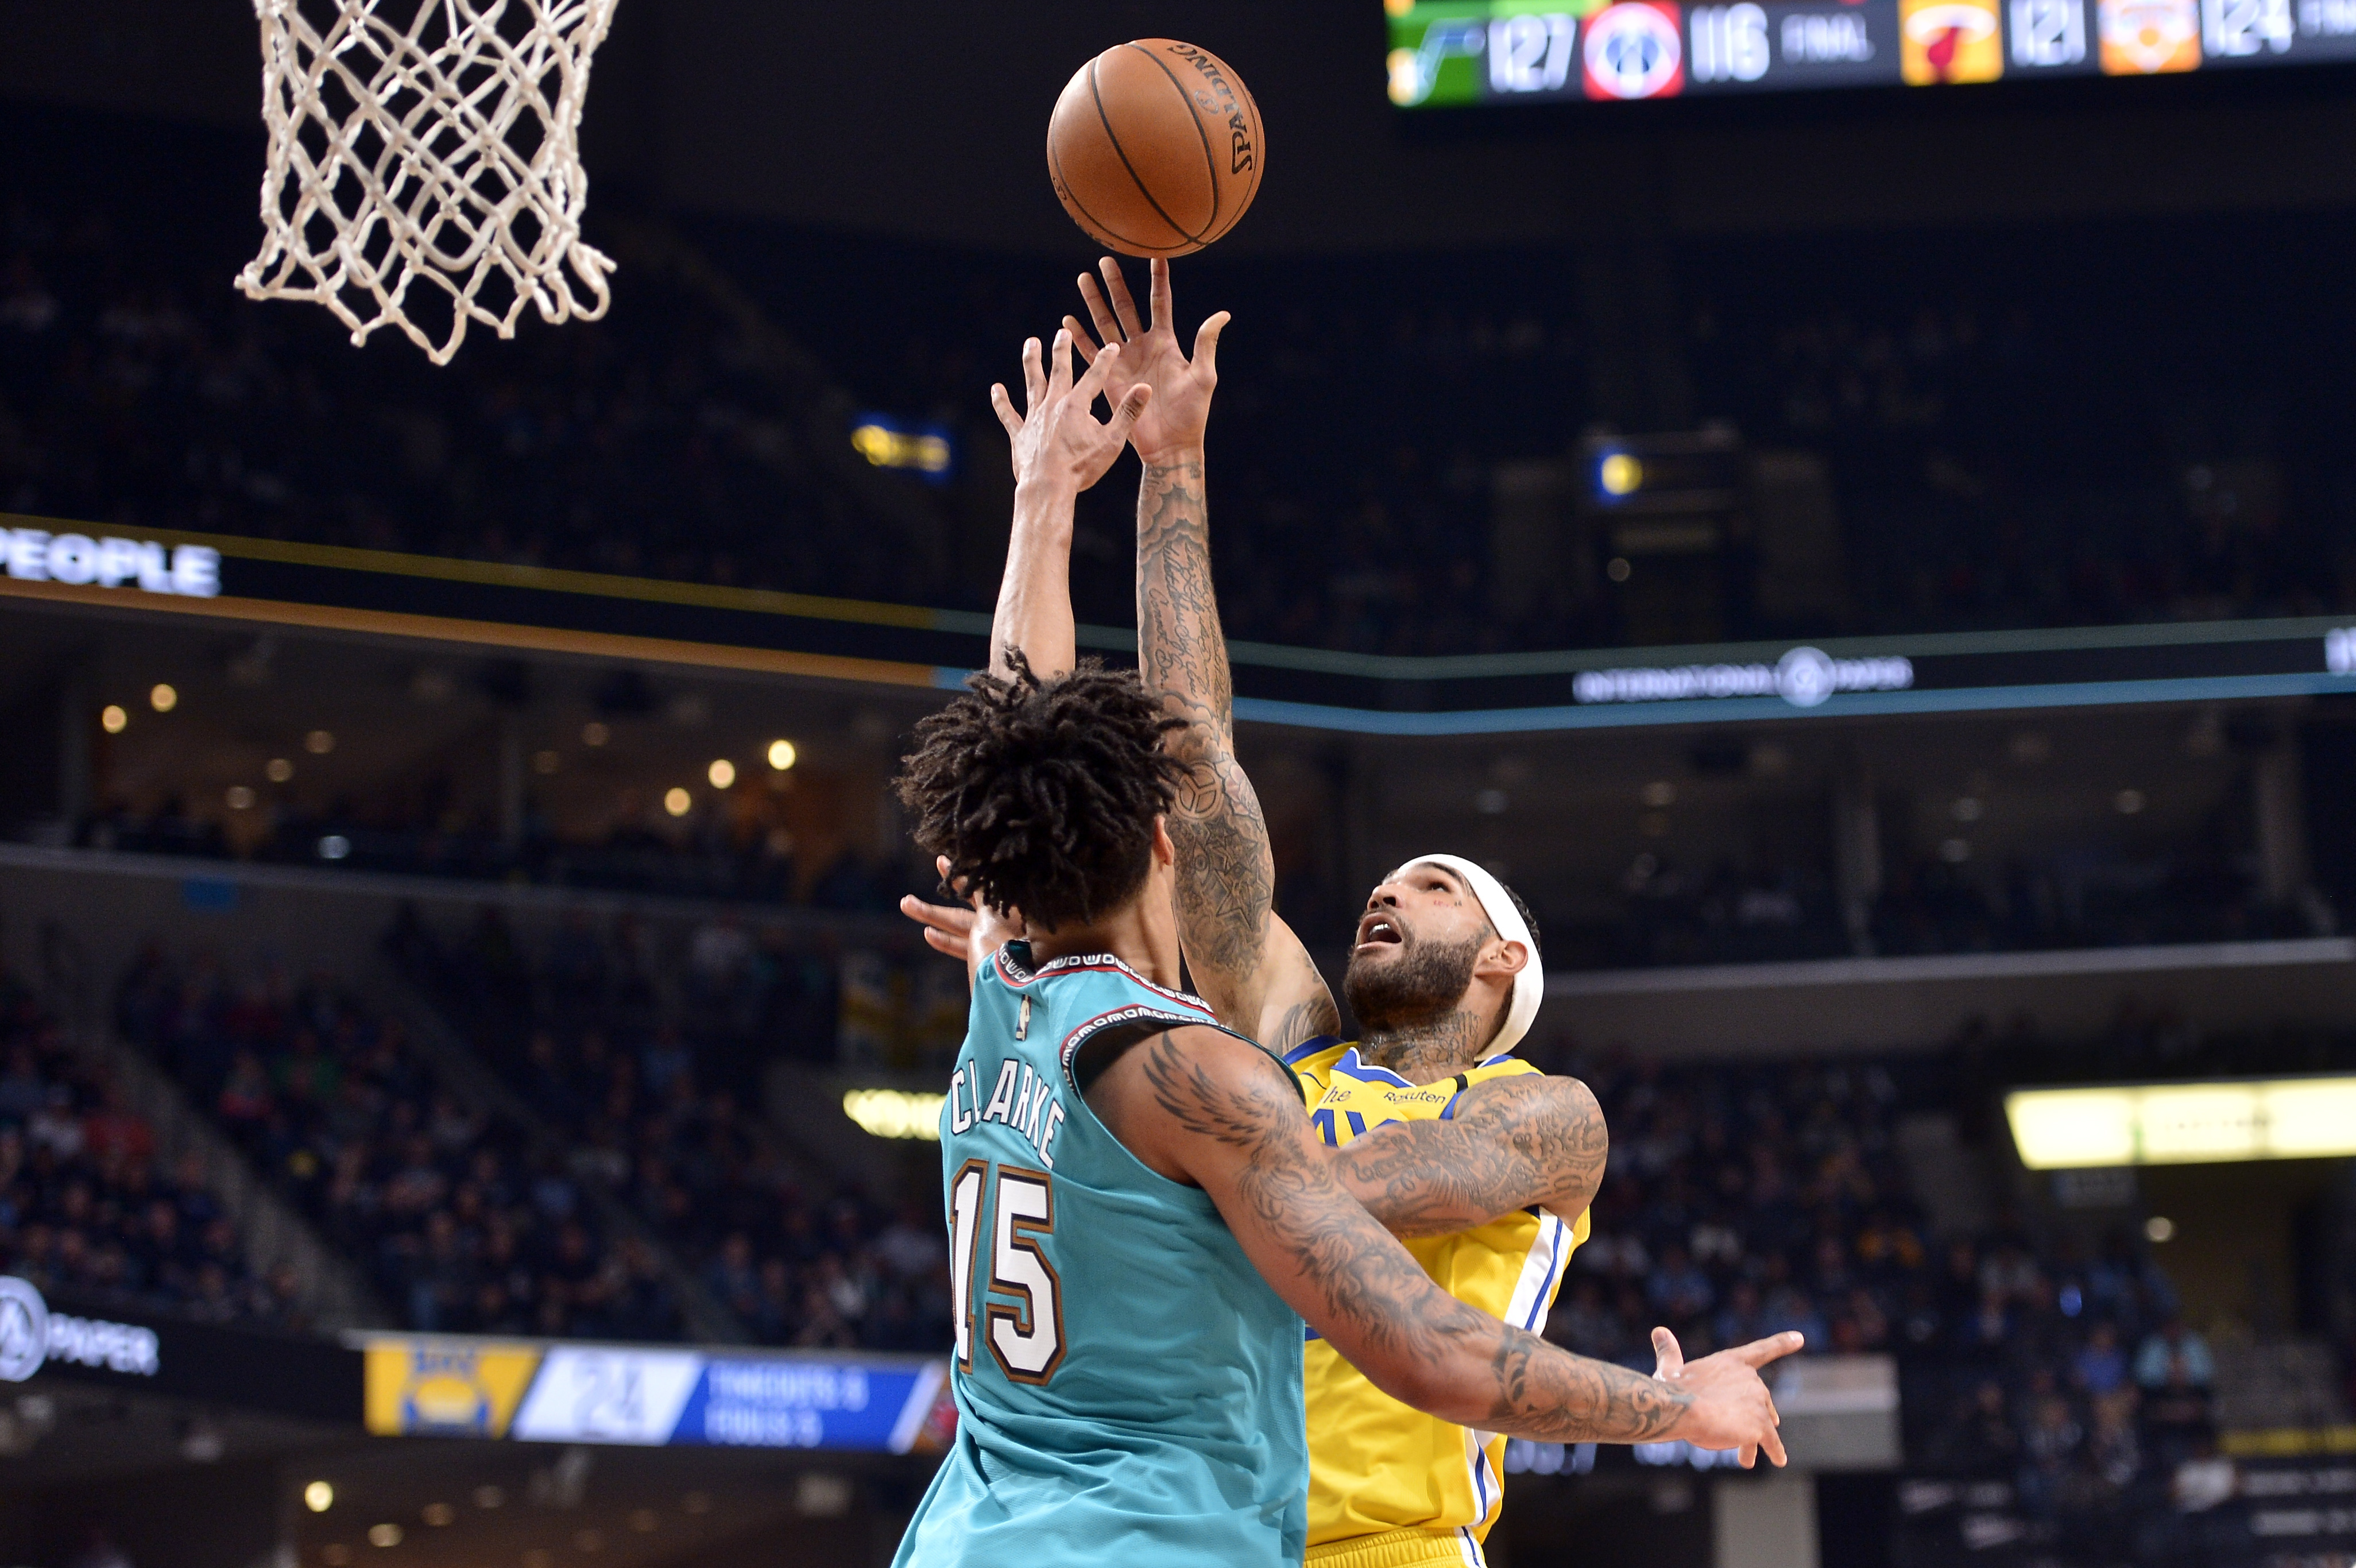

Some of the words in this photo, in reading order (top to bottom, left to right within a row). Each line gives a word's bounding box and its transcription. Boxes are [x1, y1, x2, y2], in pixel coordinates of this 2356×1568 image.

[1488, 13, 1577, 92] 127
[1690, 2, 1771, 83] 116
[2010, 0, 2087, 67] 121
[1167, 44, 1253, 175] SPALDING
[0, 526, 222, 598] EOPLE
[951, 1058, 1066, 1170] CLARKE
[1323, 1085, 1351, 1104] he
[950, 1159, 1066, 1386] 15
[48, 1312, 160, 1376] PAPER
